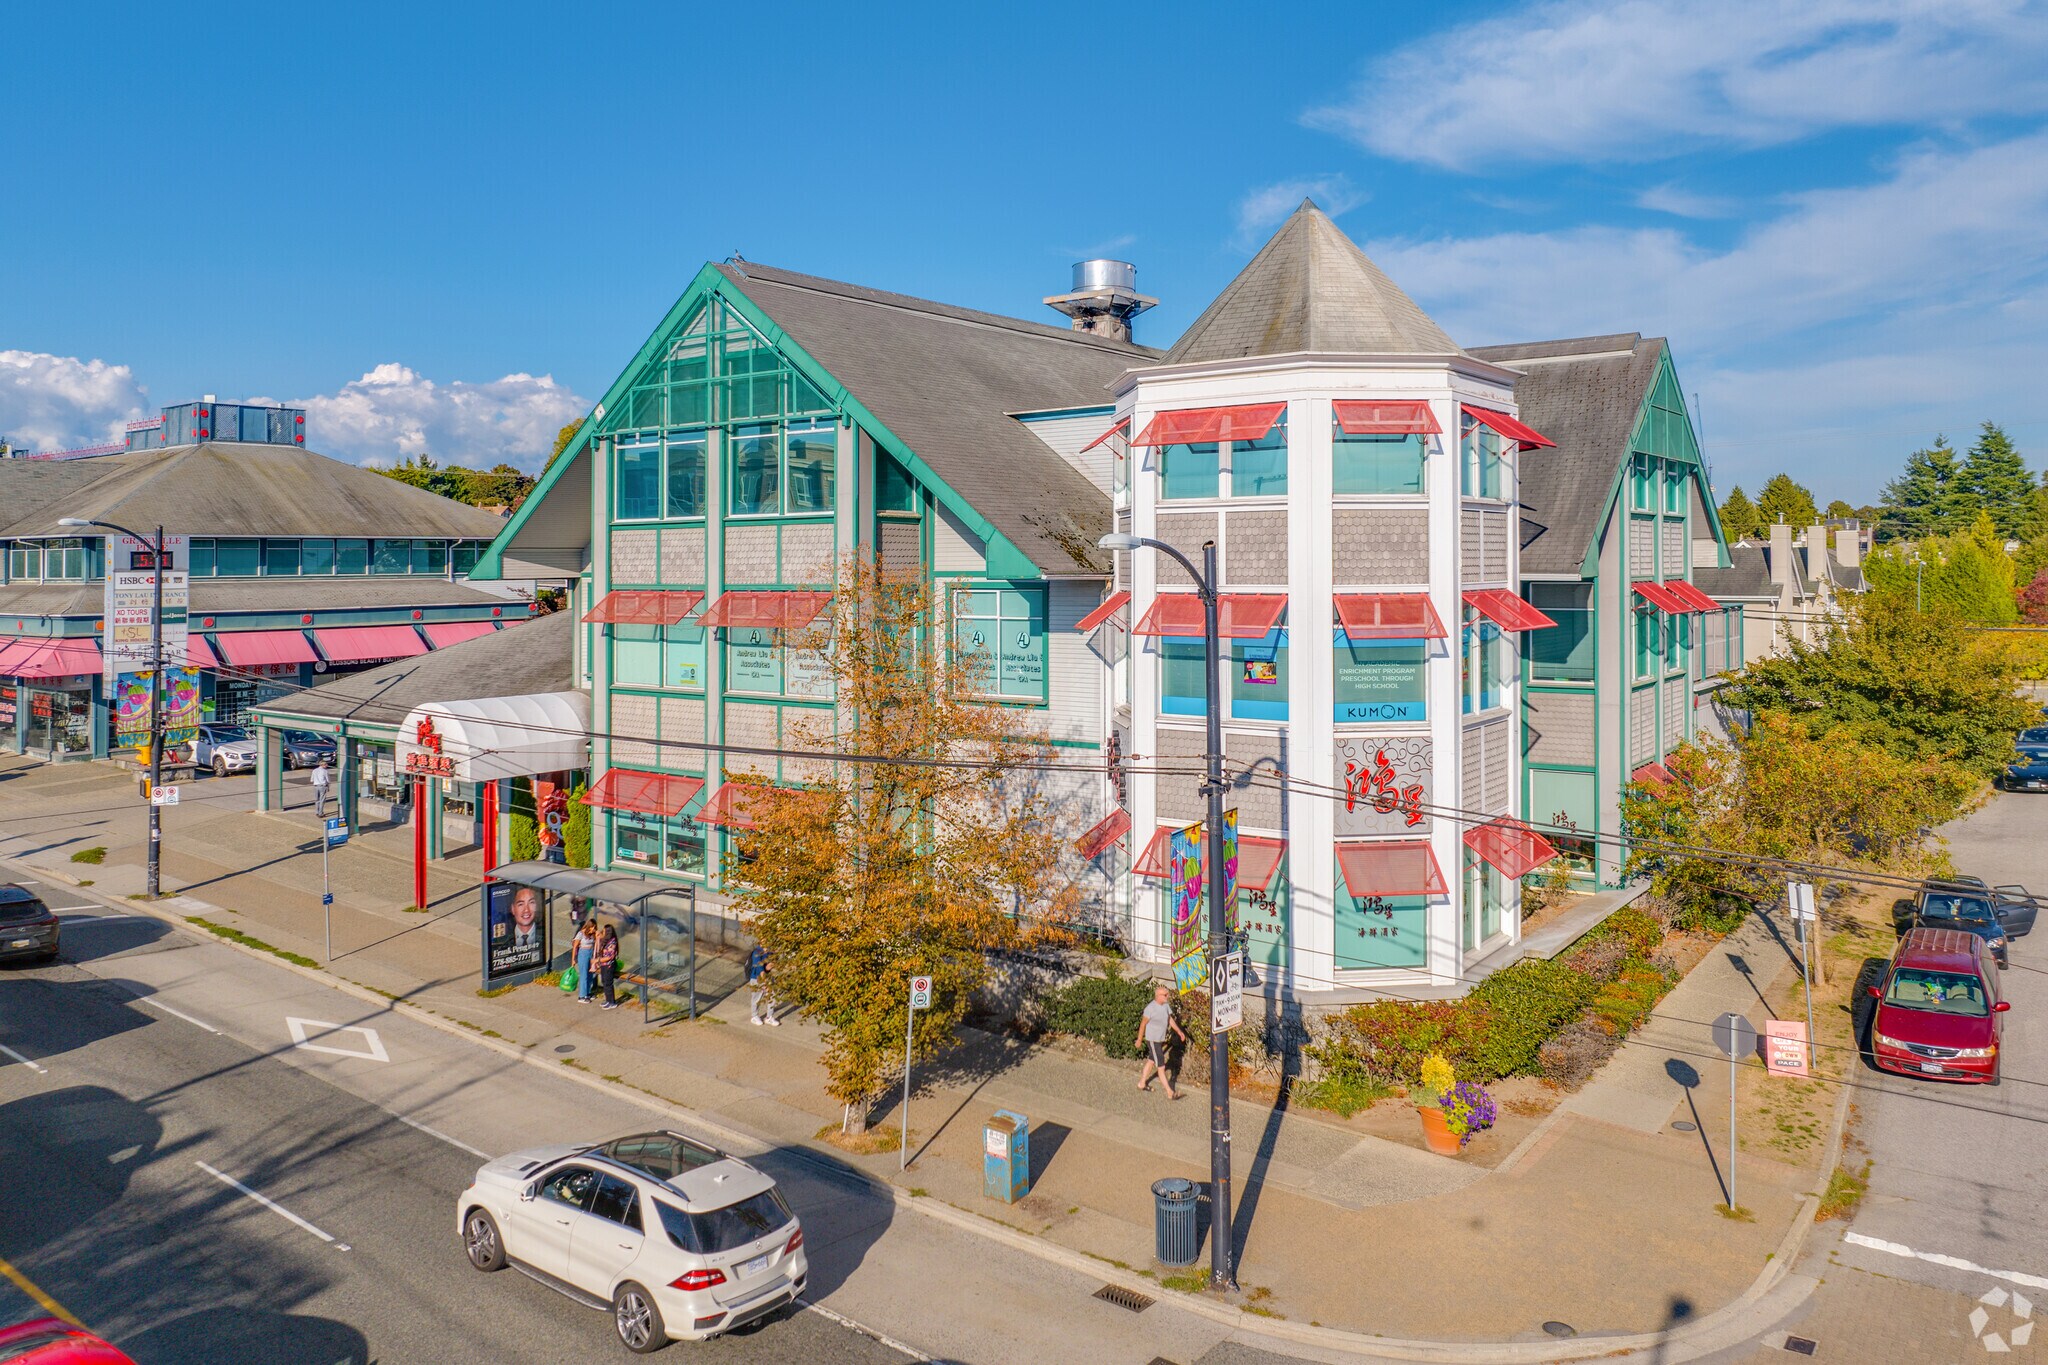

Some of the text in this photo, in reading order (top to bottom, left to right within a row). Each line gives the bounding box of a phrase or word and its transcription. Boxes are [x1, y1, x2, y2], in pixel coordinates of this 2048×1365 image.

[119, 576, 145, 585] HSBC
[1347, 704, 1407, 720] KUMON
[493, 947, 512, 958] Frank
